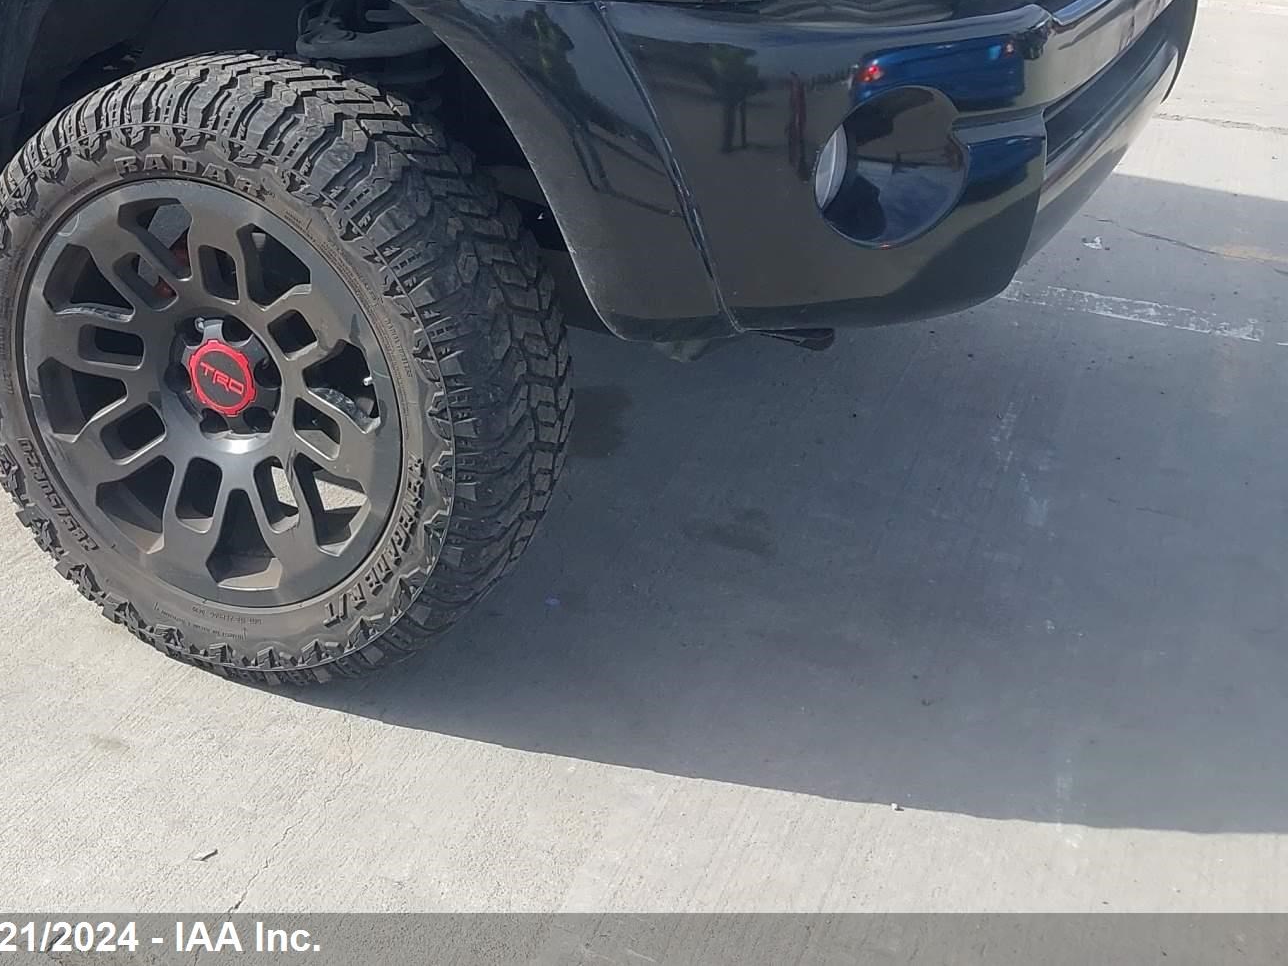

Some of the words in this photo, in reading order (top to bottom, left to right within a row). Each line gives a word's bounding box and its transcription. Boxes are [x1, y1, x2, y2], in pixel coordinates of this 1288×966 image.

[113, 153, 268, 202] RADAR
[200, 361, 245, 396] TRD
[366, 448, 425, 597] RENEGADE
